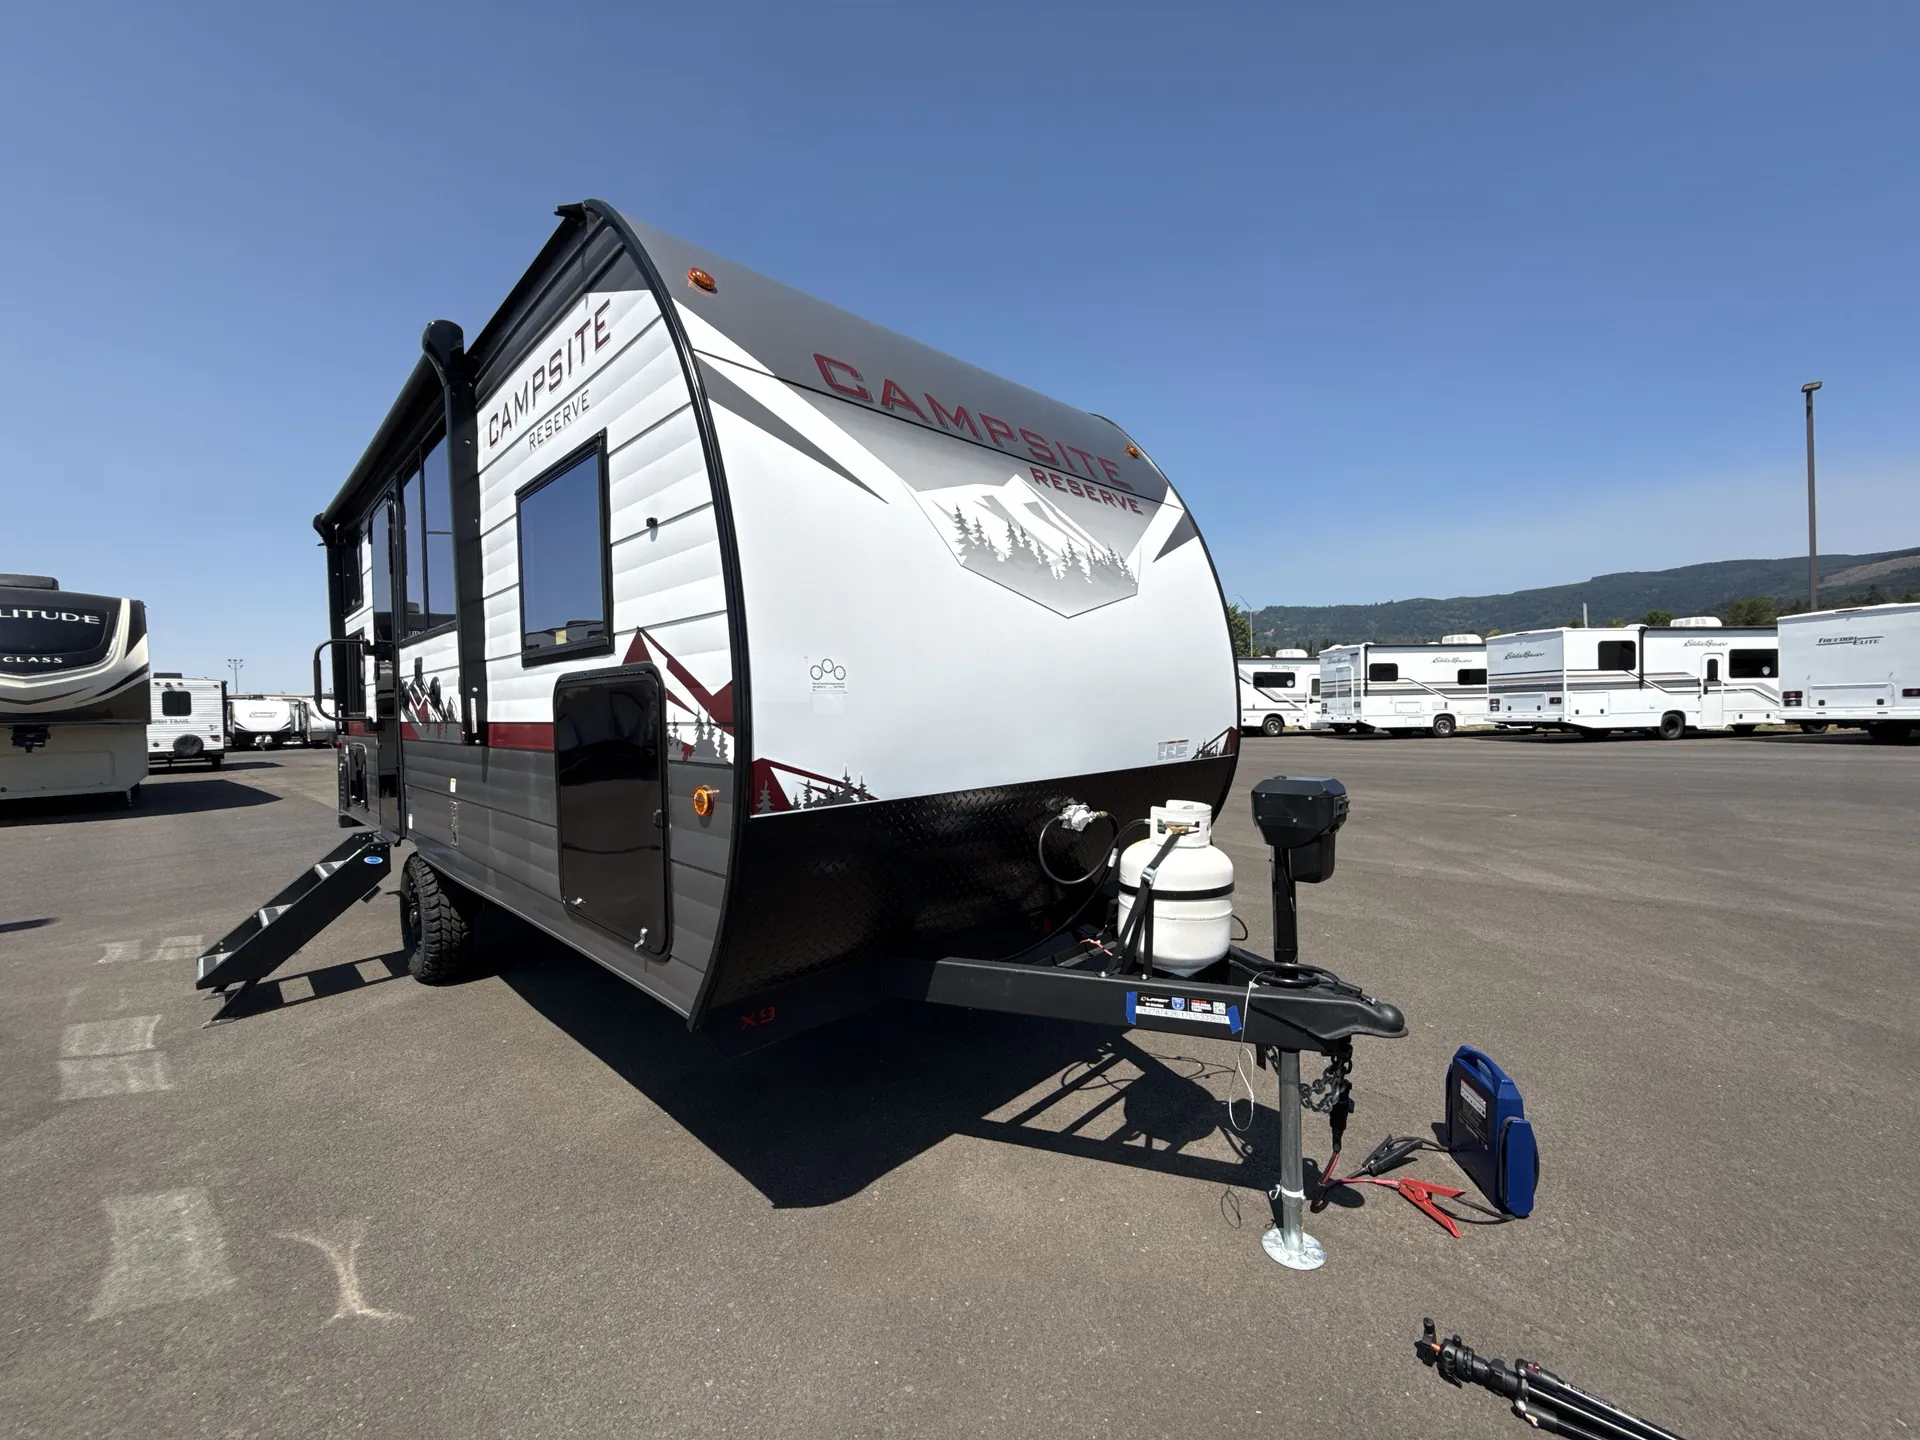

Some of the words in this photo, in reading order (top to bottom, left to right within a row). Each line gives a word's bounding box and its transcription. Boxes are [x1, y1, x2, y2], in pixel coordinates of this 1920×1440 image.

[488, 298, 611, 449] CAMPSITE
[528, 389, 590, 451] RESERVE
[812, 353, 1135, 491] CAMPSITE
[1029, 466, 1144, 516] RESERVE
[1818, 636, 1857, 644] FREEDOM
